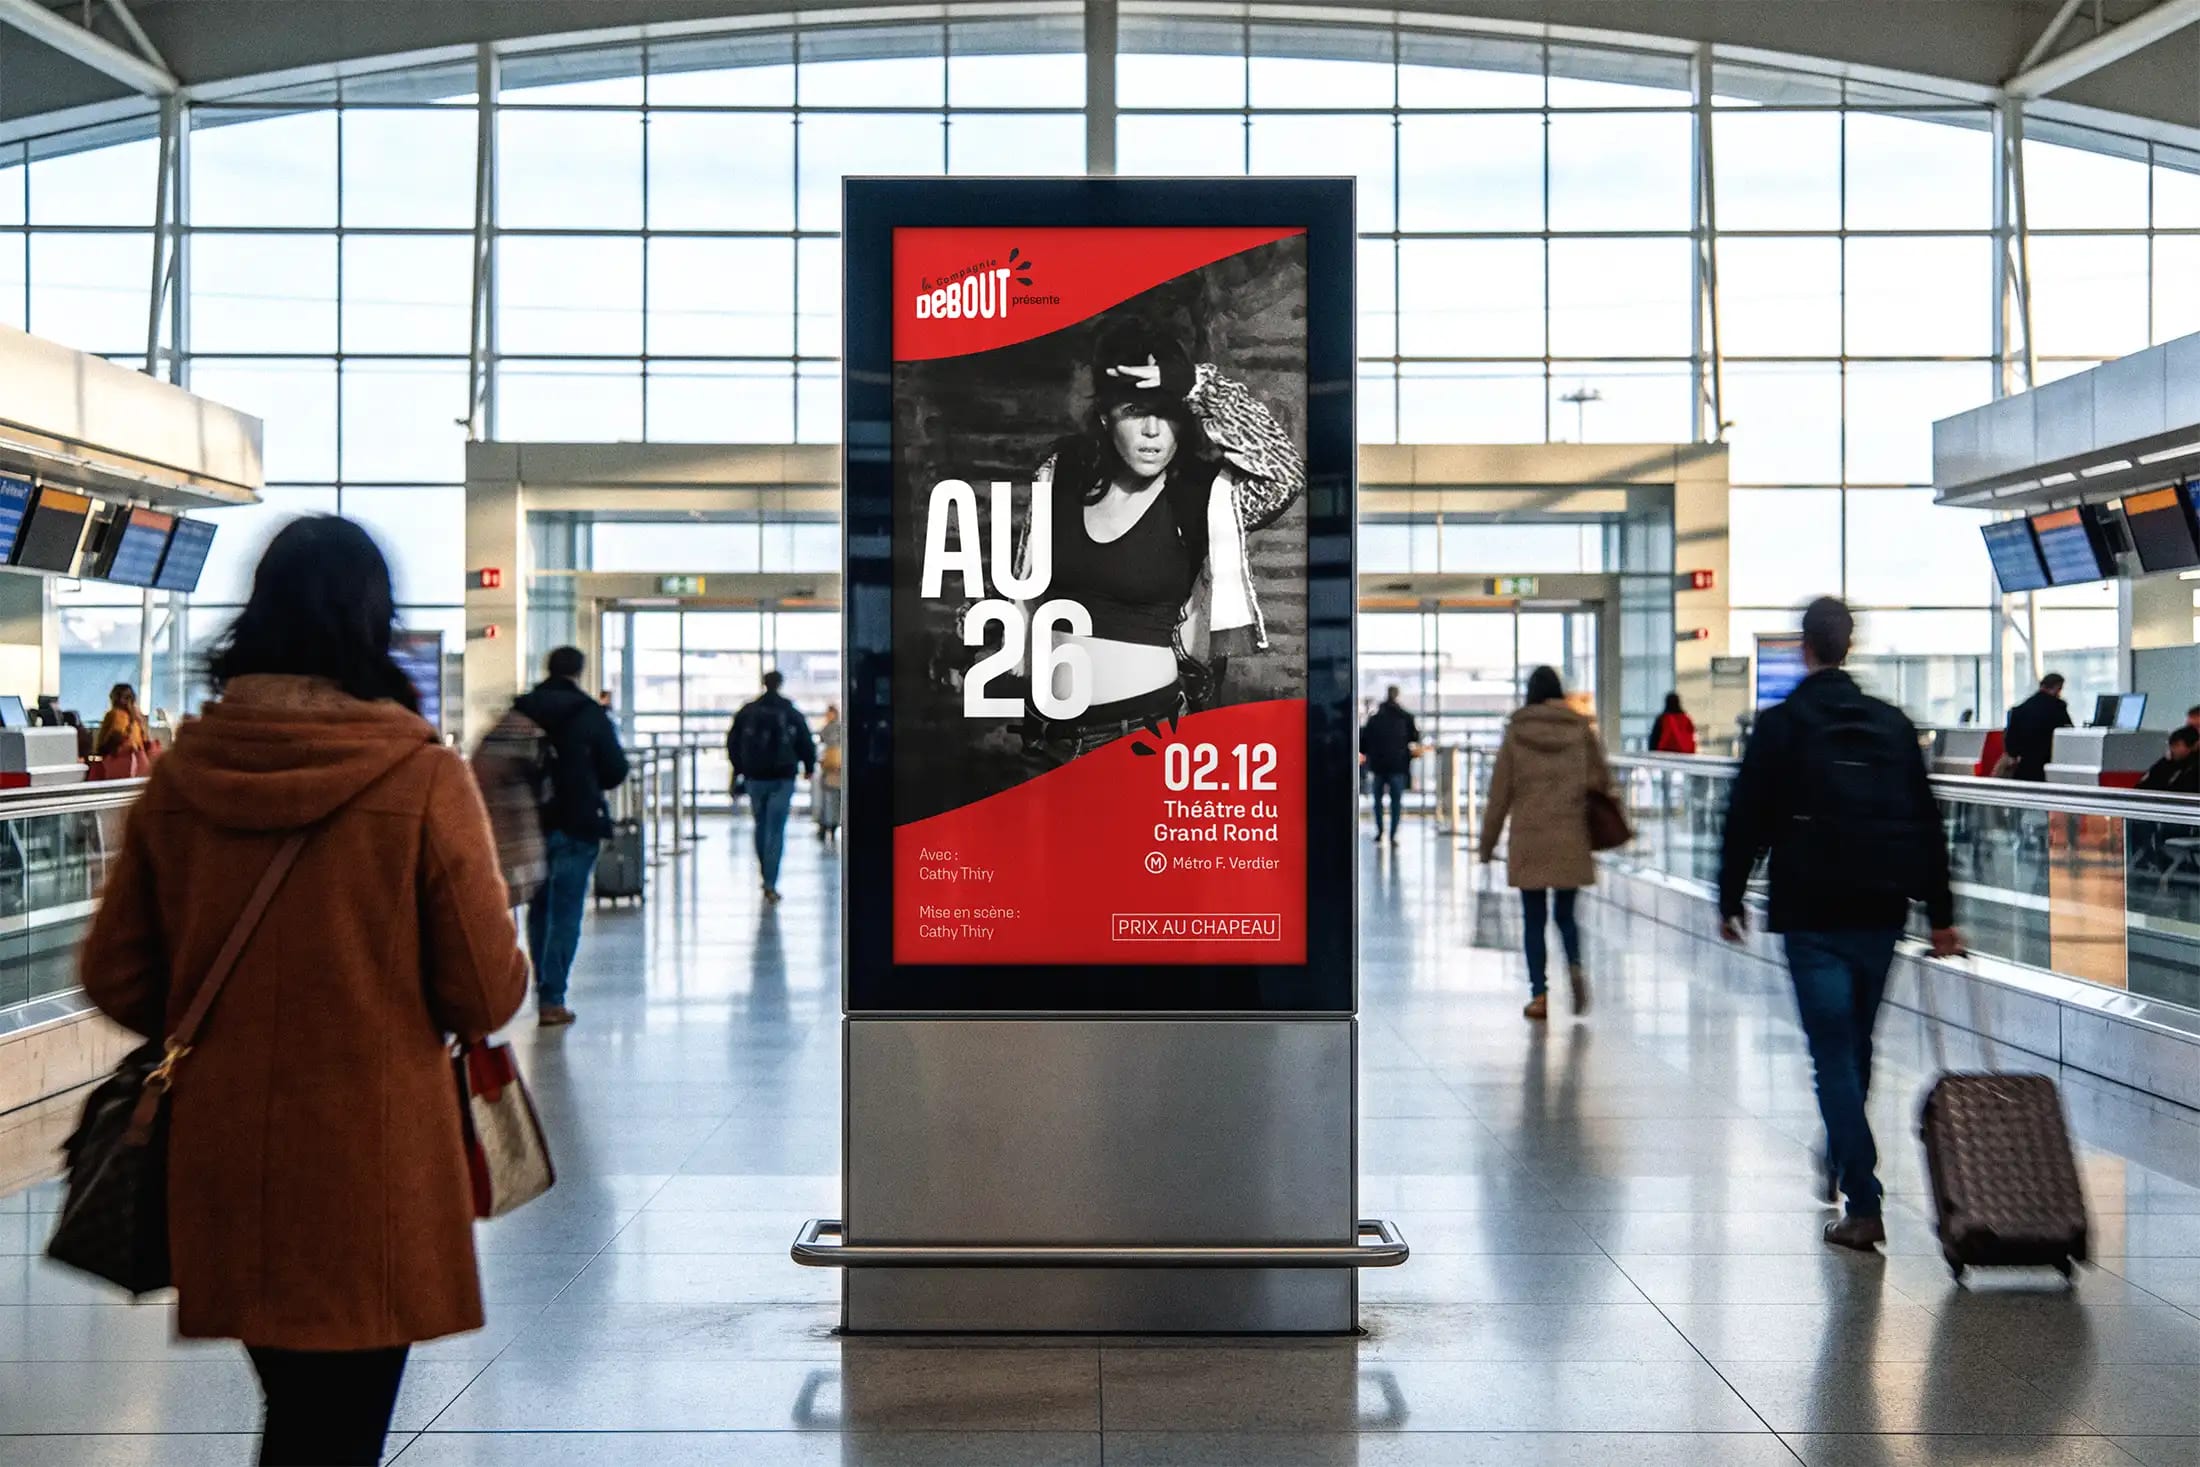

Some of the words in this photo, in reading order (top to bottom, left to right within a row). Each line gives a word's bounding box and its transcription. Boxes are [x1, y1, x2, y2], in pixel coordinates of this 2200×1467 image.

[1012, 295, 1061, 308] présente
[920, 479, 1053, 600] AU
[963, 599, 1094, 720] 26
[1164, 742, 1278, 792] 02.12
[1163, 799, 1246, 819] Théâtre
[1251, 800, 1279, 819] du
[1153, 823, 1218, 842] Grand
[1223, 823, 1279, 842] Rond
[919, 847, 952, 861] Avec
[1173, 856, 1212, 870] Métro
[1215, 857, 1227, 870] F.
[1229, 856, 1280, 870] Verdier
[919, 866, 958, 882] Cathy
[960, 866, 994, 882] Thiry
[919, 905, 951, 919] Mise
[953, 908, 971, 919] en
[973, 905, 1014, 919] scène
[919, 924, 958, 940] Cathy
[960, 924, 994, 940] Thiry
[1118, 919, 1159, 935] PRIX
[1162, 919, 1187, 935] AU
[1191, 919, 1275, 935] CHAPEAU
